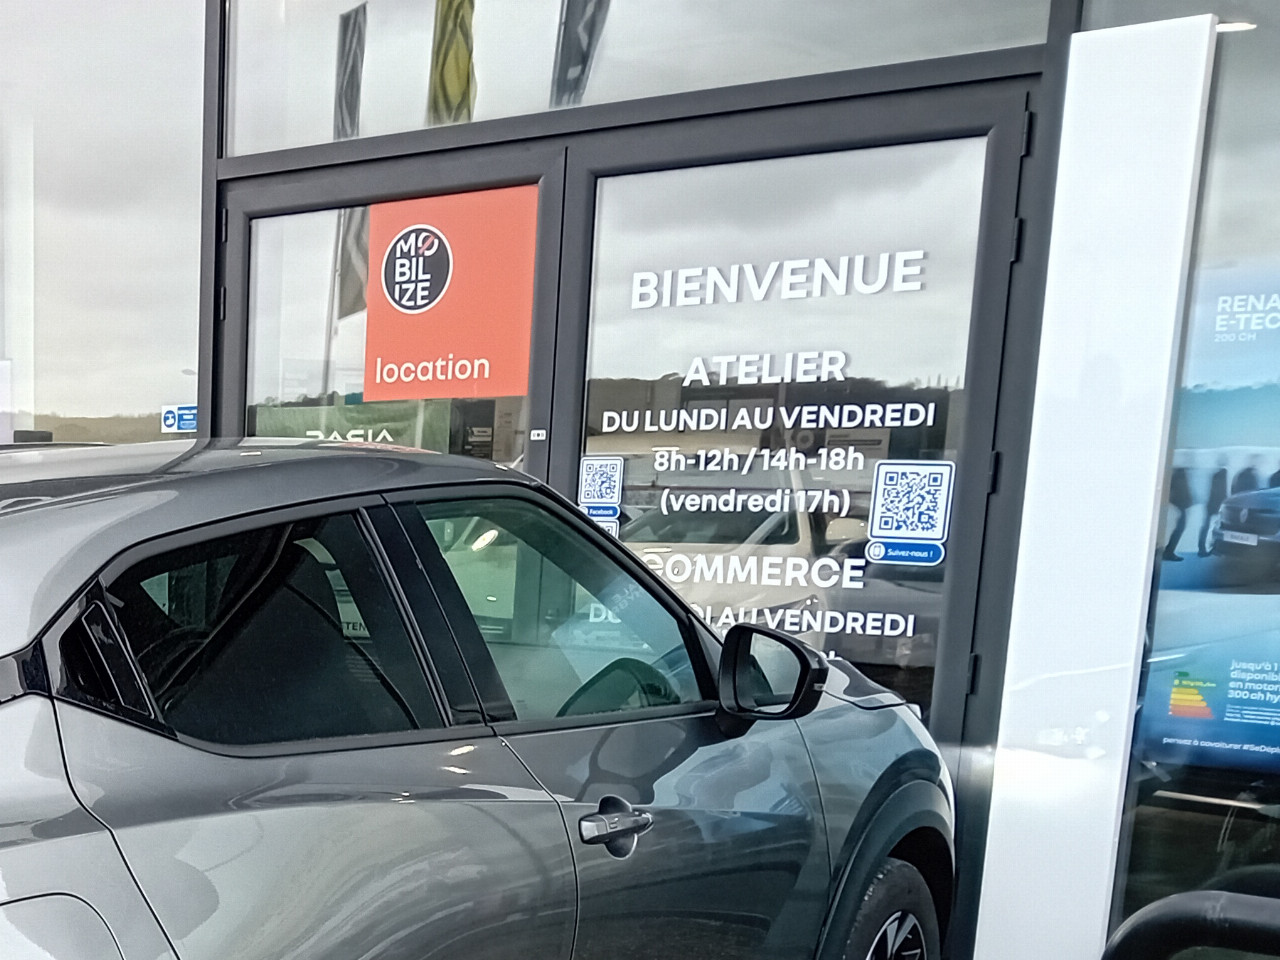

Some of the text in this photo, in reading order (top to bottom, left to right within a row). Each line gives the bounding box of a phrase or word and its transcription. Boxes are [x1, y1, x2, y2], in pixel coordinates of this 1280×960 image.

[631, 250, 926, 309] BIENVENUE
[375, 353, 490, 384] location
[682, 350, 847, 387] ATELIER
[602, 402, 936, 433] DU LUNDI AU VENDREDI
[660, 488, 852, 517] (vendredi 17h)
[763, 607, 915, 637] VENDREDI
[1227, 690, 1249, 699] 300
